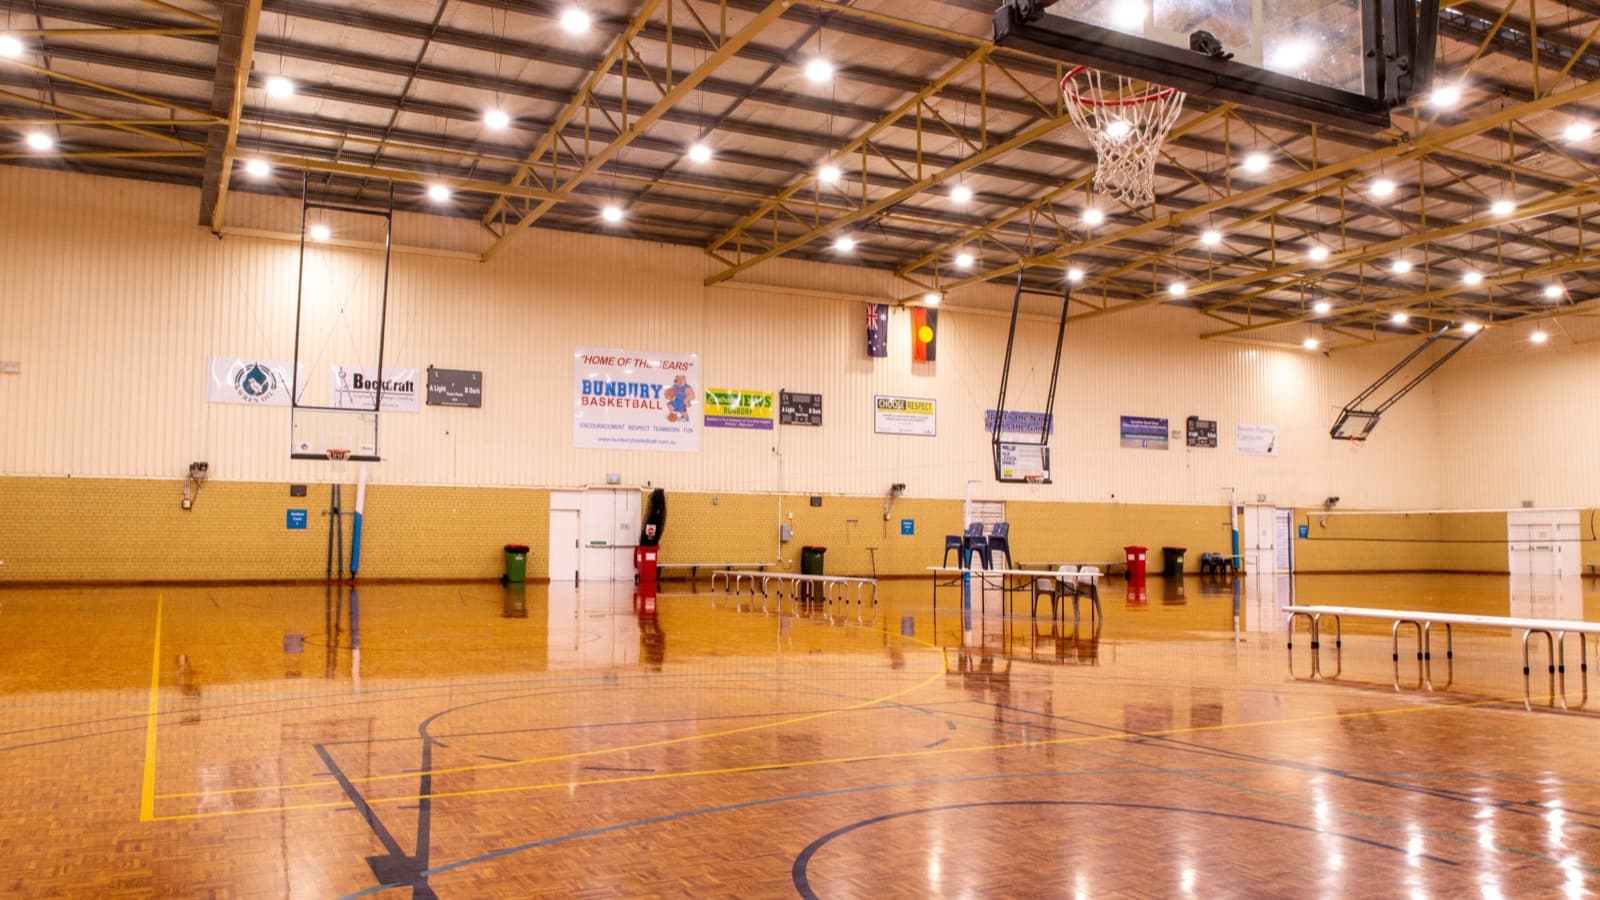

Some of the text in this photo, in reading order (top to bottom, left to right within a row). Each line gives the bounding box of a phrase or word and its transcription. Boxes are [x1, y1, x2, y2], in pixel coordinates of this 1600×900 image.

[617, 357, 632, 367] OF
[582, 379, 663, 400] BUNBURY
[581, 396, 663, 410] BASKETBALL
[879, 399, 932, 411] CHOOSE RESPECT
